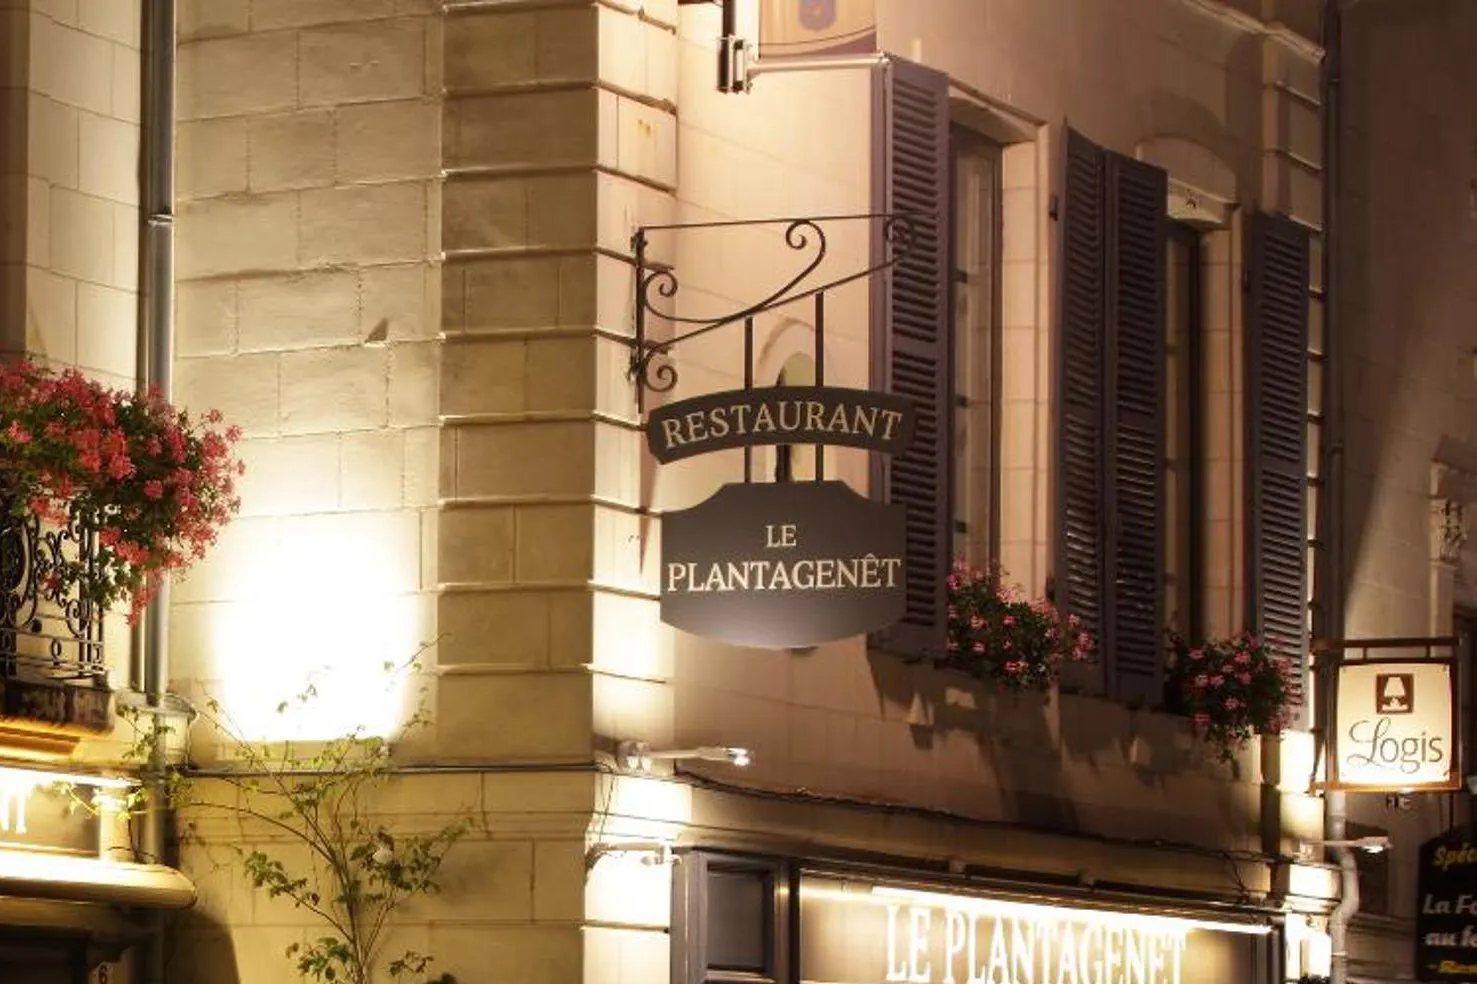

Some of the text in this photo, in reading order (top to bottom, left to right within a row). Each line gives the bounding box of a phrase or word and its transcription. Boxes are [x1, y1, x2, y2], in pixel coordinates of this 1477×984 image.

[661, 400, 902, 450] RESTAURANT
[765, 524, 797, 548] LE
[667, 553, 901, 592] PLANTAGENÊT
[1346, 716, 1443, 774] Logis
[1422, 894, 1450, 914] La
[886, 905, 931, 983] LE
